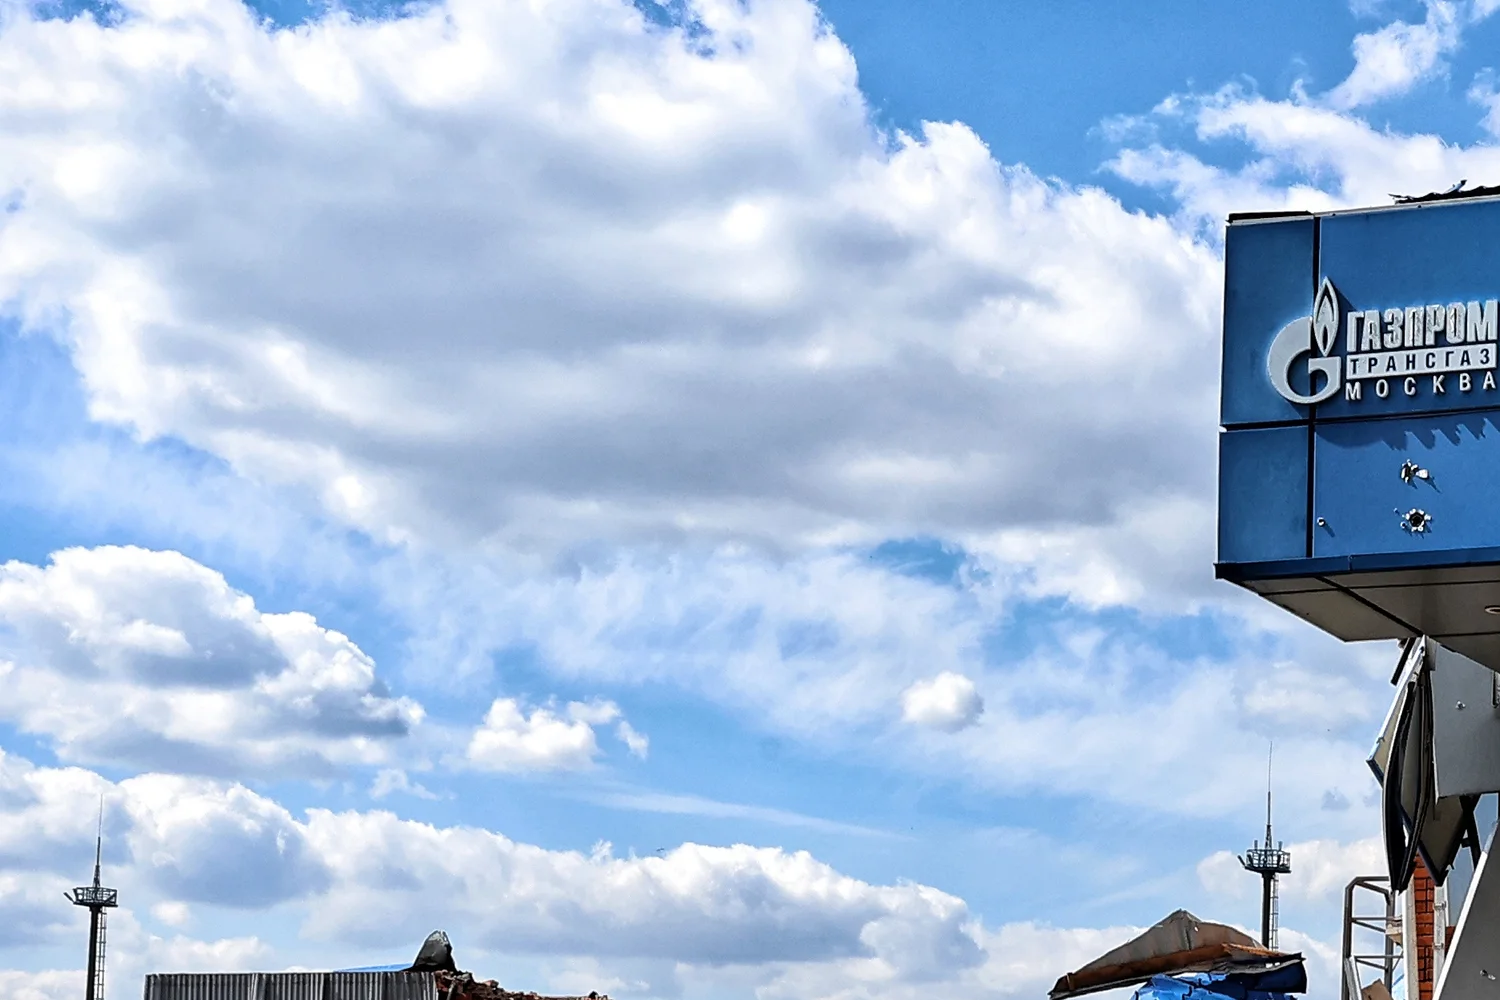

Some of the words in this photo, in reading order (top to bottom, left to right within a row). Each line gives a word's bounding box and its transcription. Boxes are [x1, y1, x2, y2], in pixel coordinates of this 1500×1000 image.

[1347, 300, 1498, 352] ГАЗПРОМ
[1351, 349, 1491, 374] ТРАНСГАЗ
[1345, 371, 1496, 400] МОСКВА
